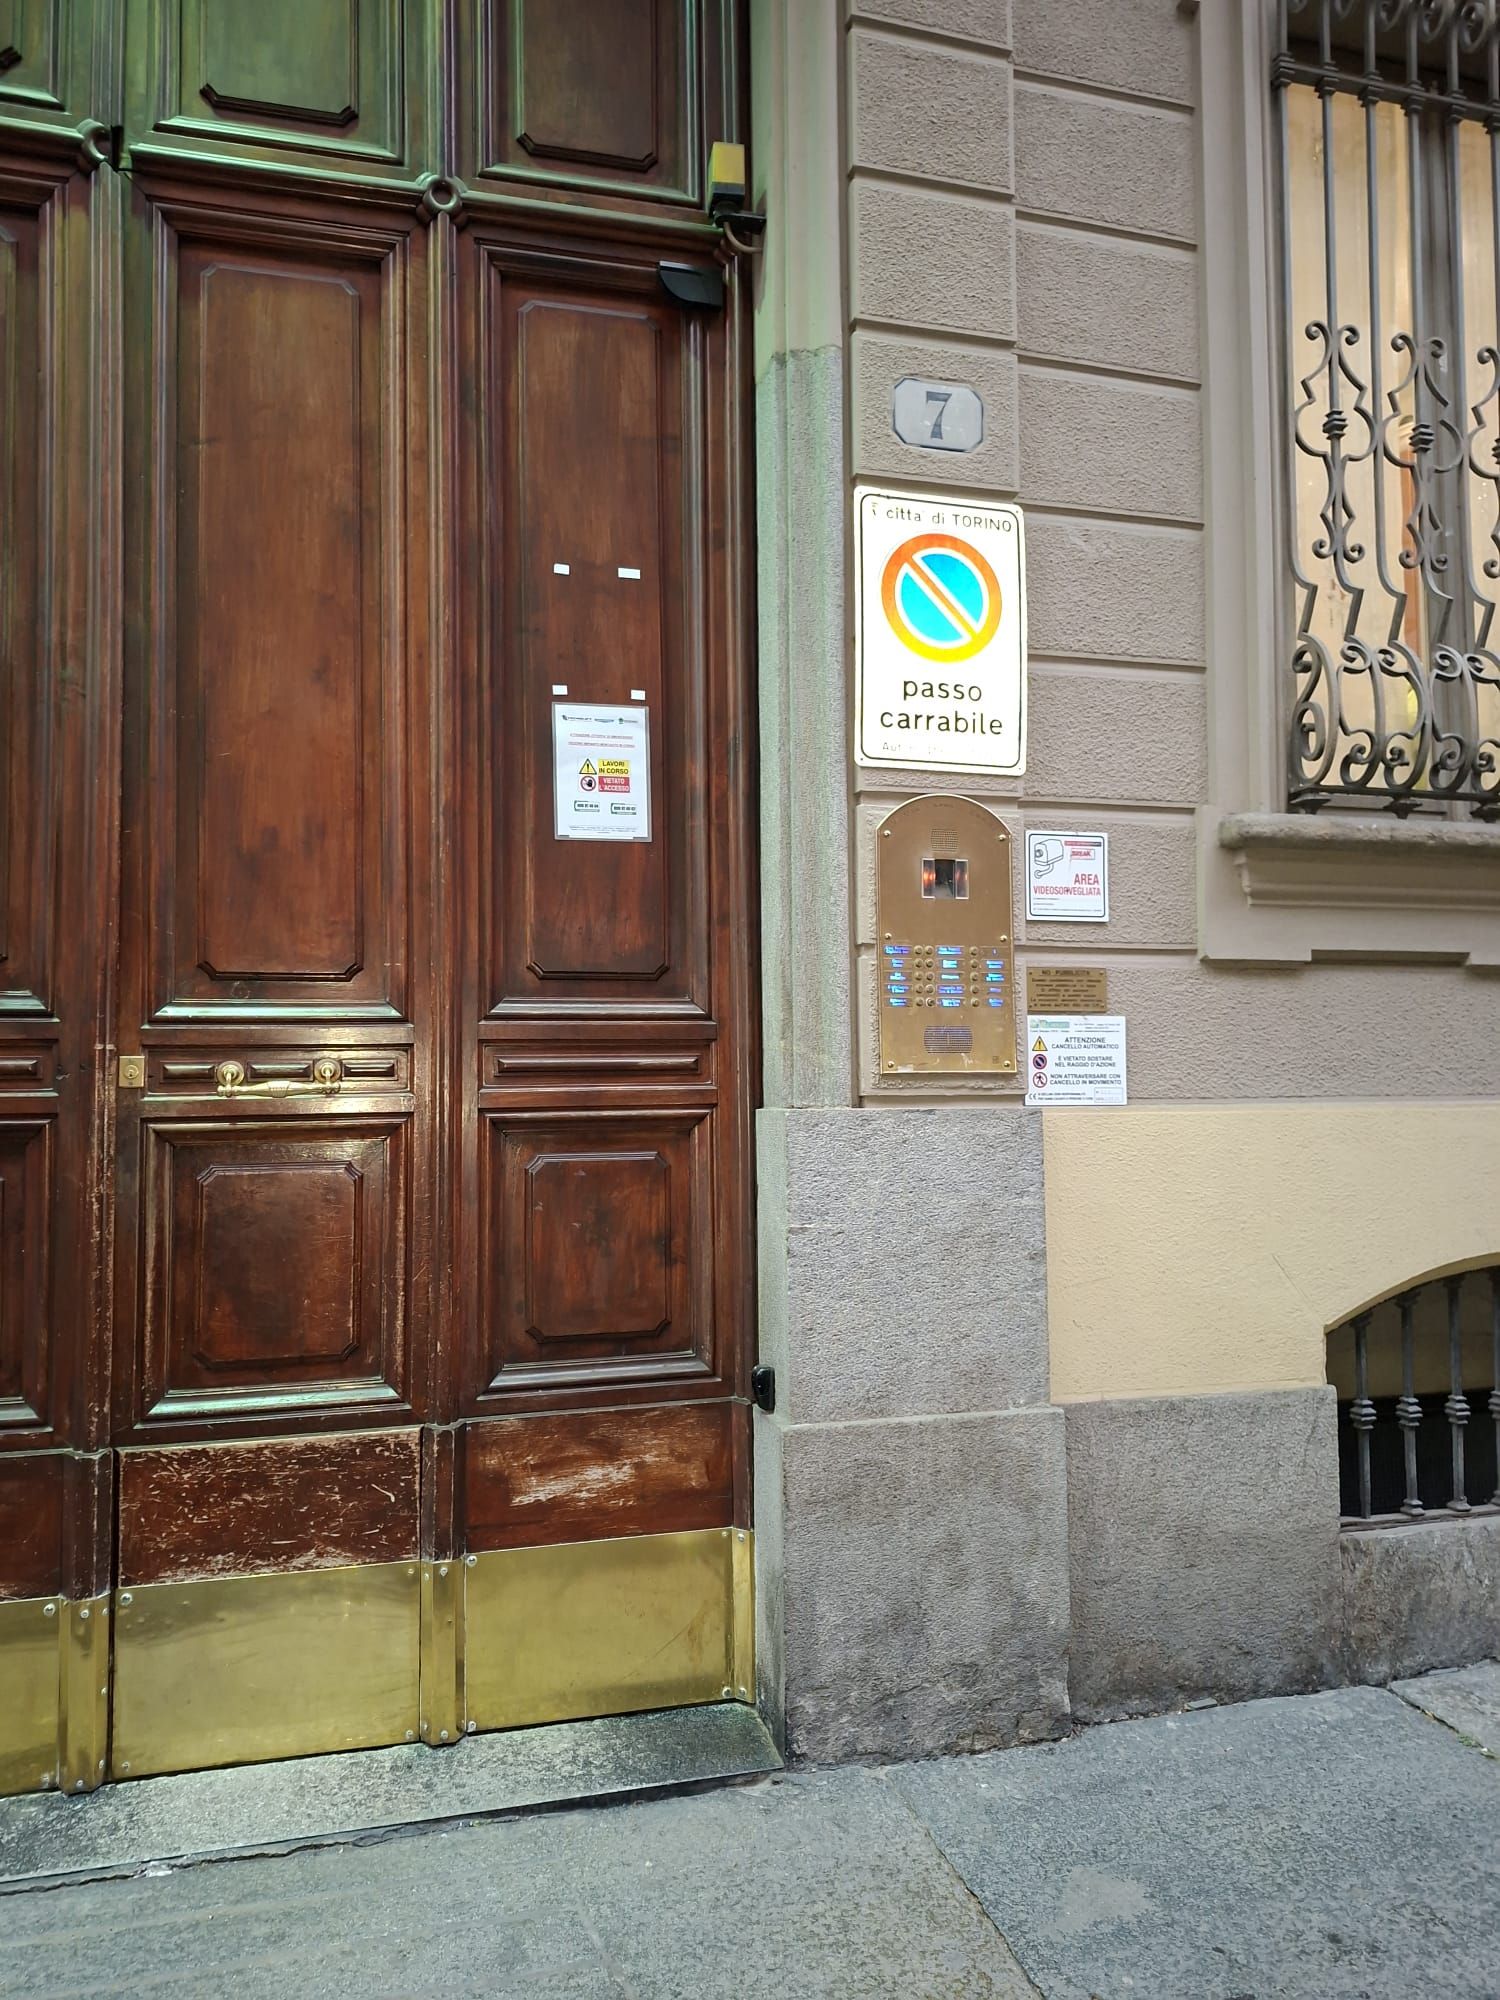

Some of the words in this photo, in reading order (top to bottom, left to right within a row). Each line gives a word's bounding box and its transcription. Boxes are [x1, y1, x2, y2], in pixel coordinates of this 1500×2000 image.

[926, 391, 952, 440] 7
[932, 512, 945, 524] di
[952, 514, 1012, 532] TORINO
[903, 680, 982, 702] passo
[880, 711, 1003, 735] carrabile
[1074, 873, 1100, 886] AREA
[1033, 885, 1101, 896] VIDEOSORVEGLIATA
